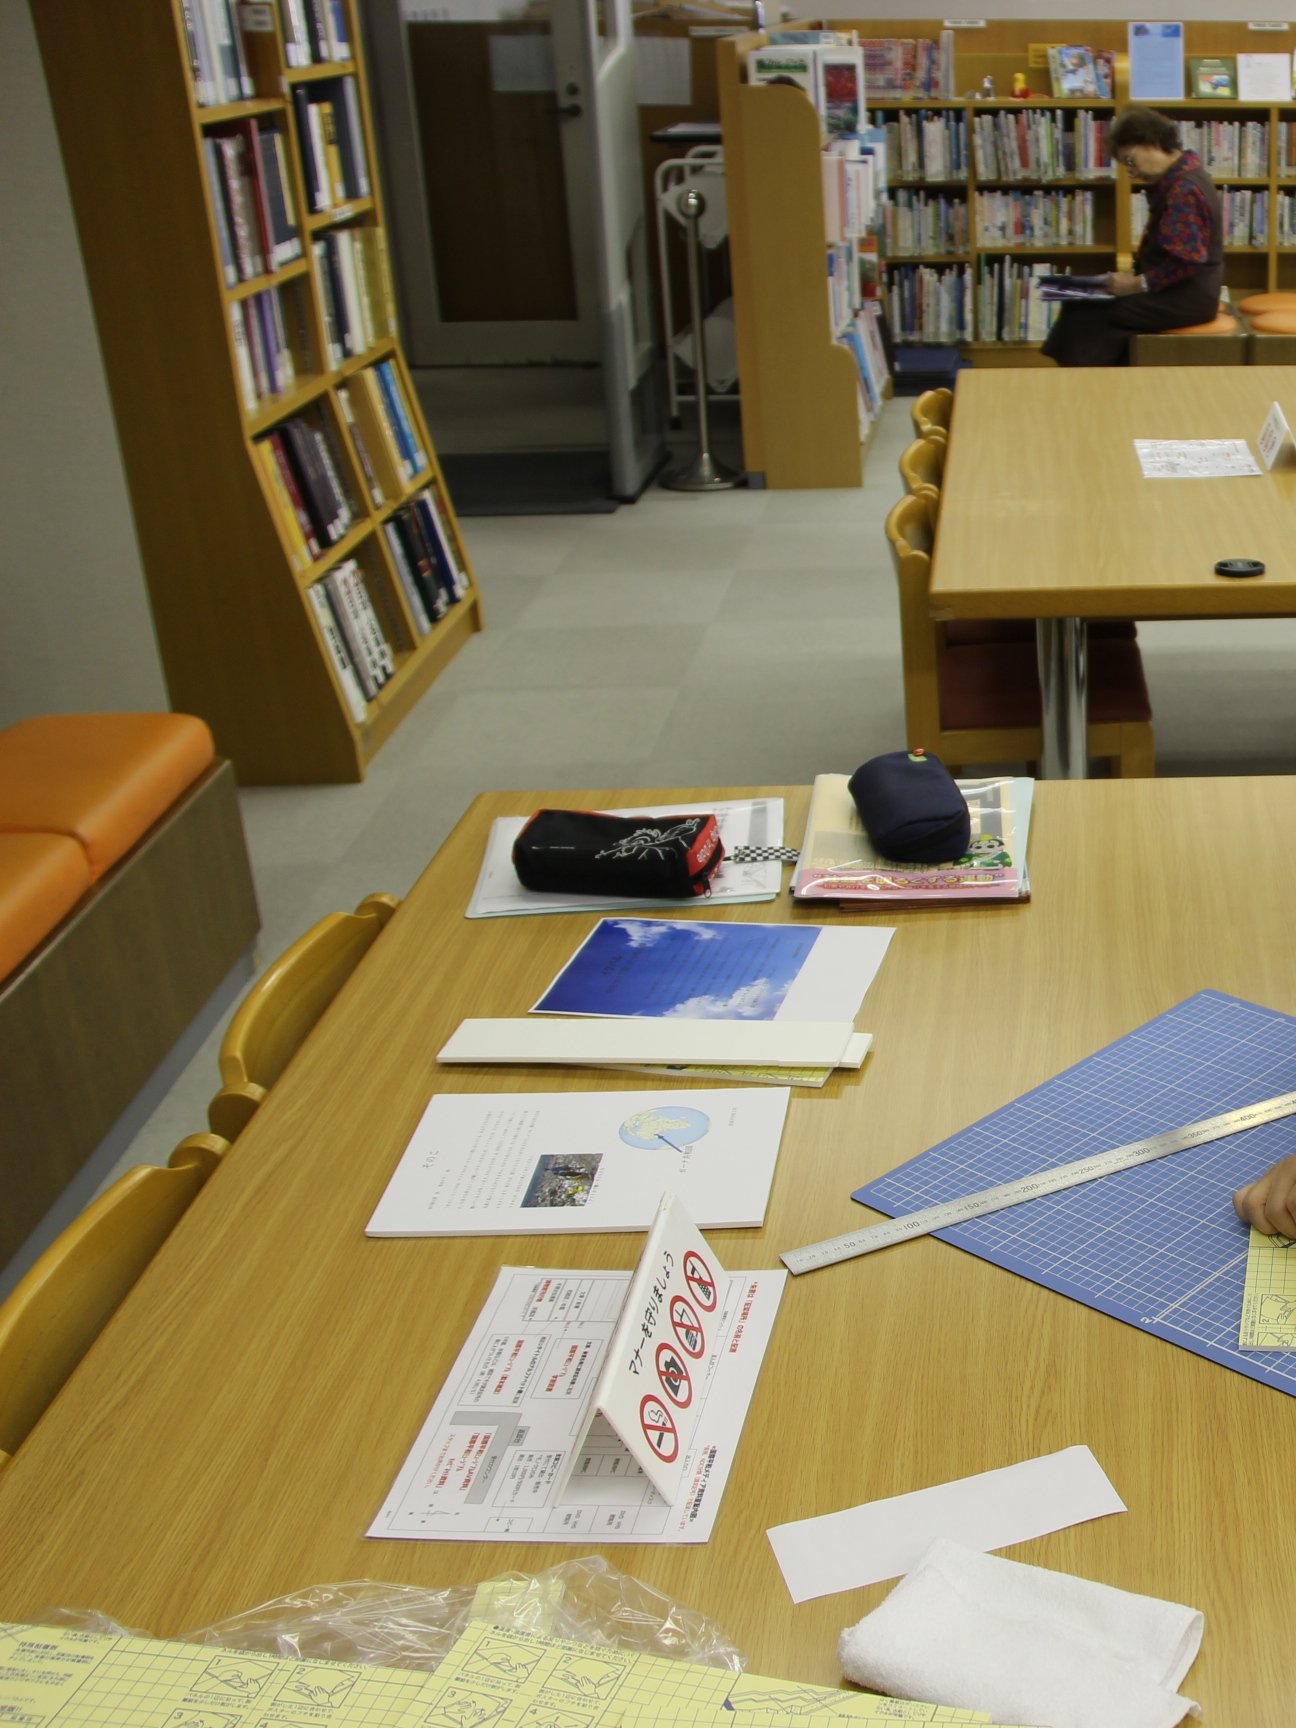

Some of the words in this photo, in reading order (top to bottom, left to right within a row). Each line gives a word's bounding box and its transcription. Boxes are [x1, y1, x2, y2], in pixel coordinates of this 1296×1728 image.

[420, 1150, 440, 1168] そのこ
[843, 1240, 856, 1249] 50
[903, 1220, 921, 1232] 100
[964, 1202, 980, 1212] 150
[1021, 1183, 1039, 1194] 200
[1078, 1164, 1095, 1174] 250
[1133, 1147, 1151, 1158] 300
[1187, 1130, 1203, 1139] 350
[1240, 1113, 1257, 1123] 400
[629, 1250, 674, 1376] マナーを守りましょう
